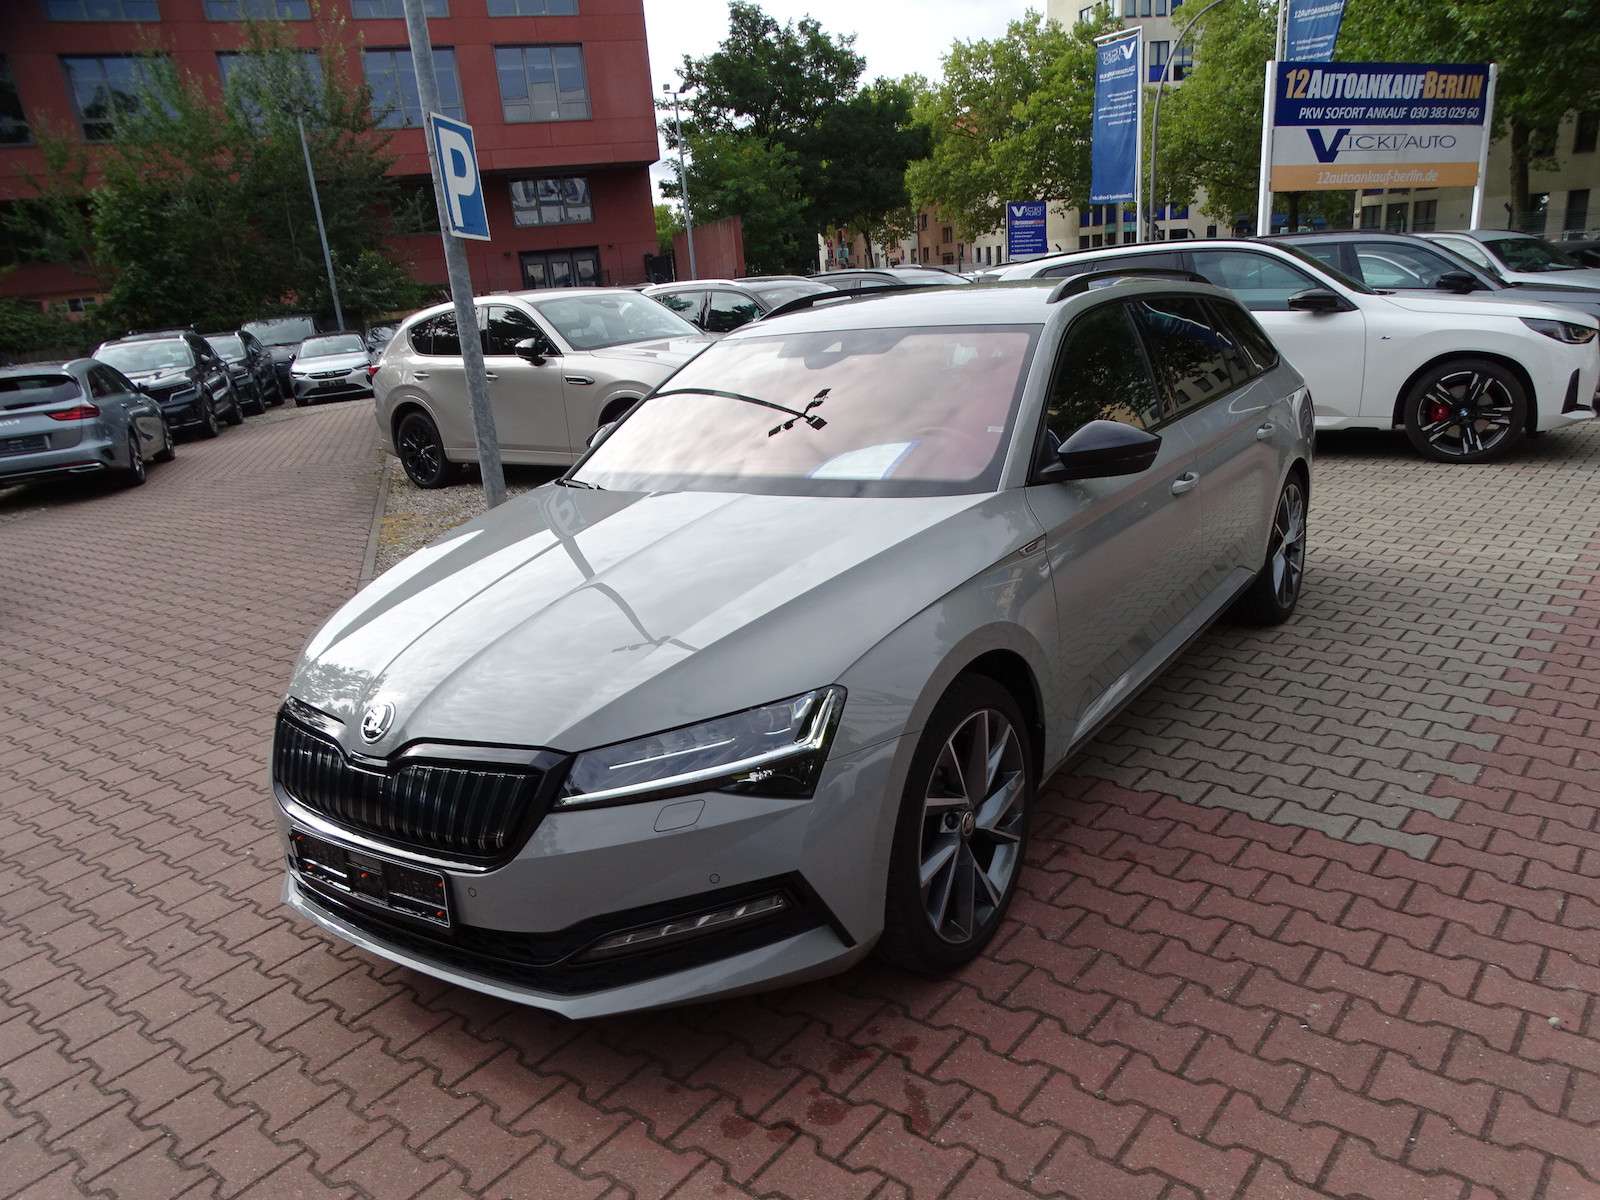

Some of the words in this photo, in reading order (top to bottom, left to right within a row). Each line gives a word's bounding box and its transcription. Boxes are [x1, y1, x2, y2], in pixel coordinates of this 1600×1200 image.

[1298, 107, 1324, 119] PKW
[1324, 107, 1366, 119] SOFORT
[1365, 107, 1407, 119] ANKAUF
[1410, 107, 1429, 119] 030
[1429, 107, 1448, 118] 383
[1448, 107, 1466, 118] 029
[438, 127, 476, 227] P
[1316, 169, 1438, 185] 12autoankauf-berlin.de
